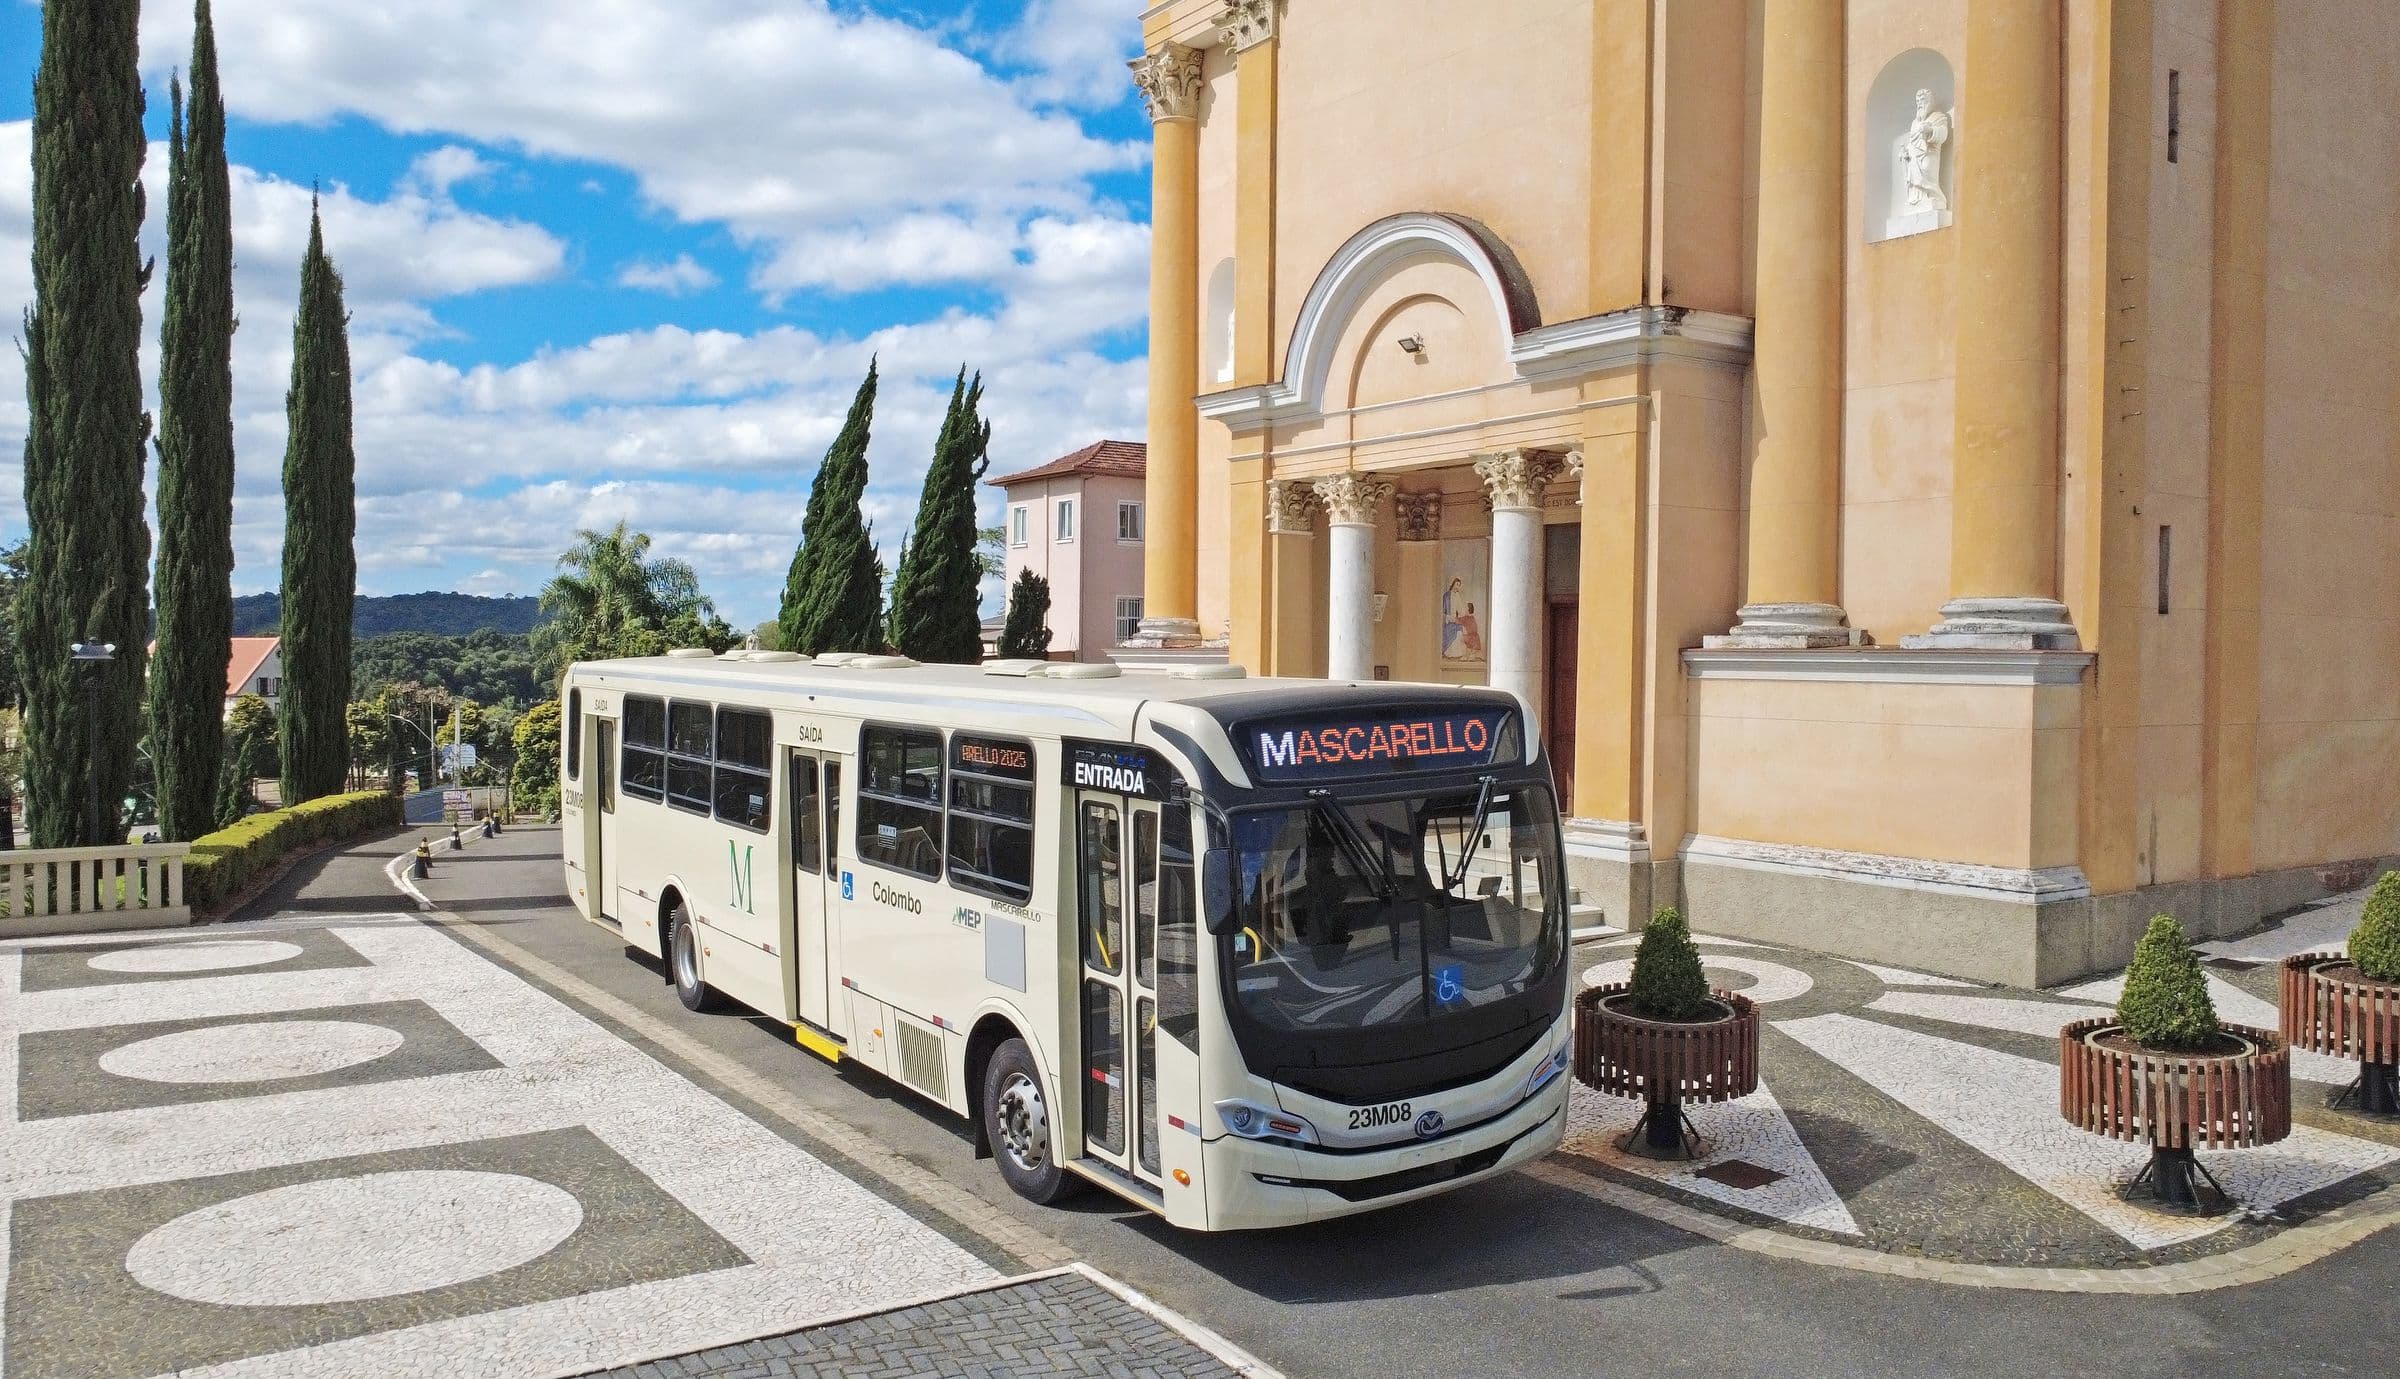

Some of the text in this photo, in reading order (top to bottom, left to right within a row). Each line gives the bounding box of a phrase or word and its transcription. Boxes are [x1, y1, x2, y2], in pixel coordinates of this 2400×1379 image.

[799, 722, 823, 744] SAÍDA
[1260, 719, 1488, 767] MASCARELLO
[1075, 762, 1145, 794] ENTRADA
[873, 880, 922, 915] Colombo
[991, 900, 1042, 923] MASCARELLO
[1348, 1103, 1412, 1130] 23M08
